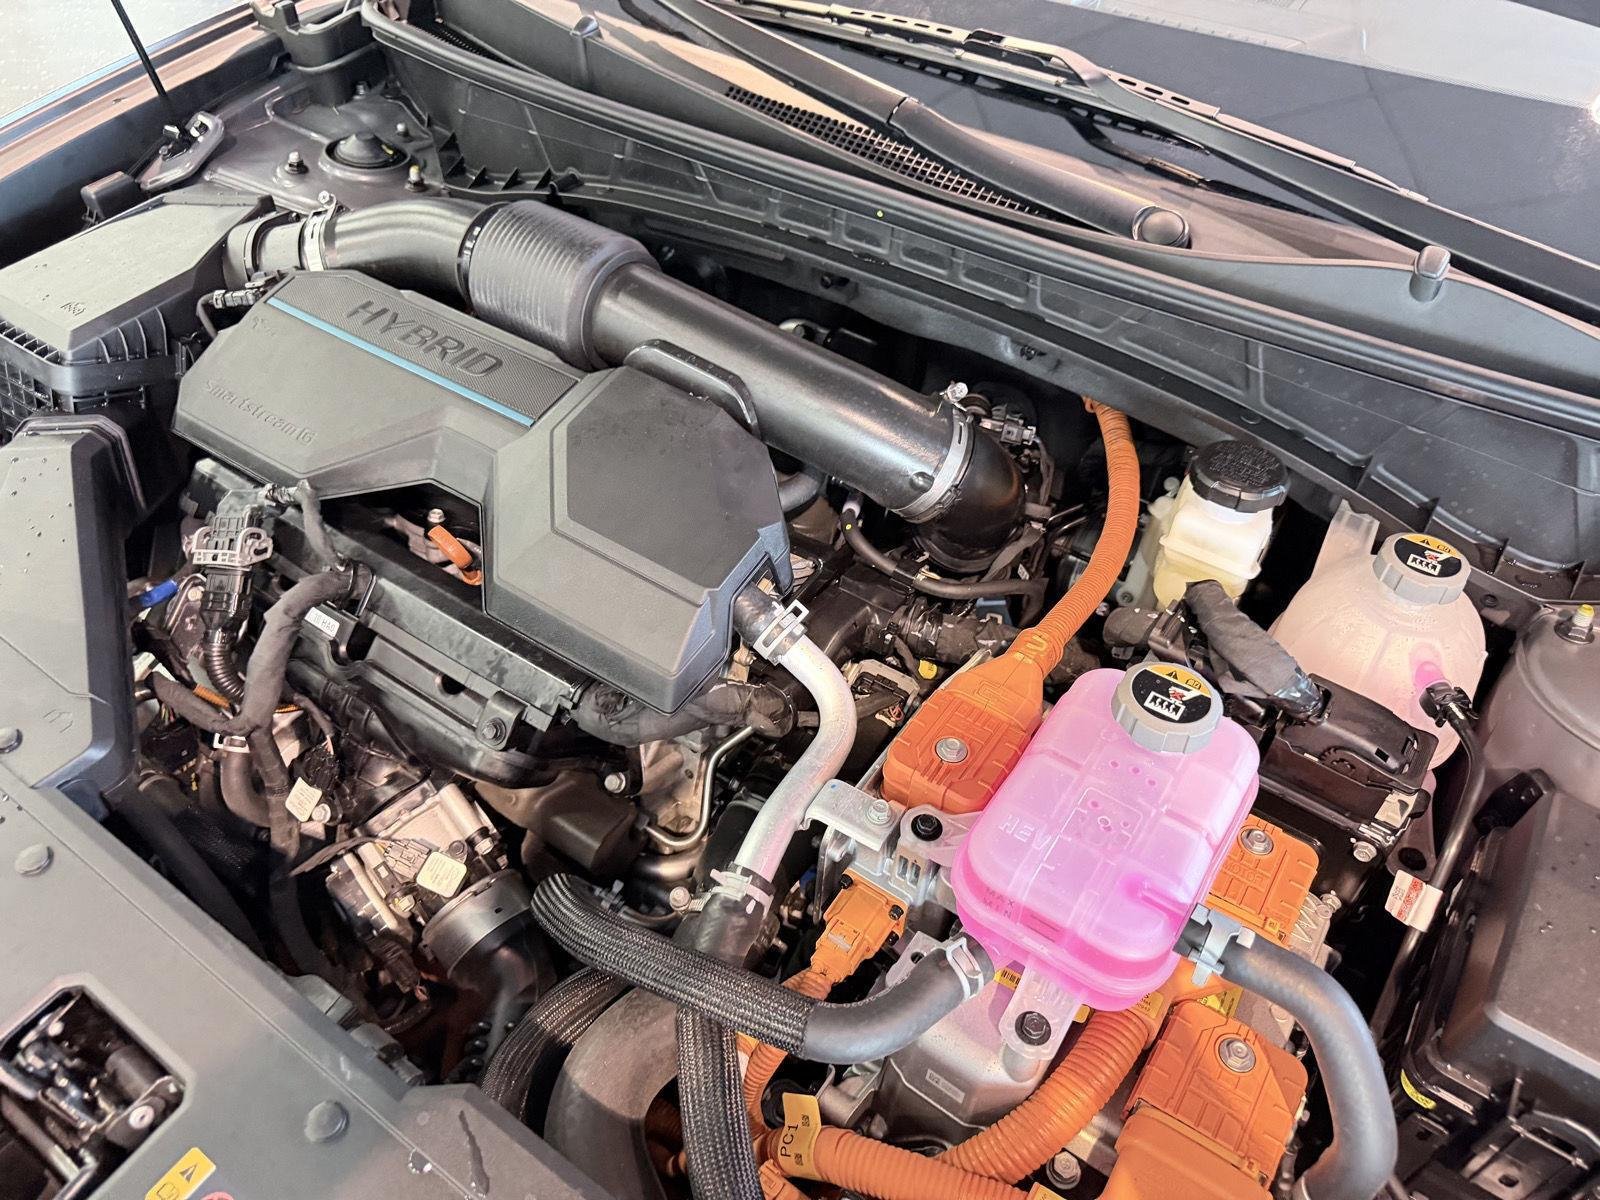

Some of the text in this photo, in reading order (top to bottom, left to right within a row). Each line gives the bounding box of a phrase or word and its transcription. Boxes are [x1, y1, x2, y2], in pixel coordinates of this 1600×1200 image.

[347, 299, 503, 377] HYBRID
[998, 814, 1052, 851] HEV
[780, 1123, 799, 1158] PC1
